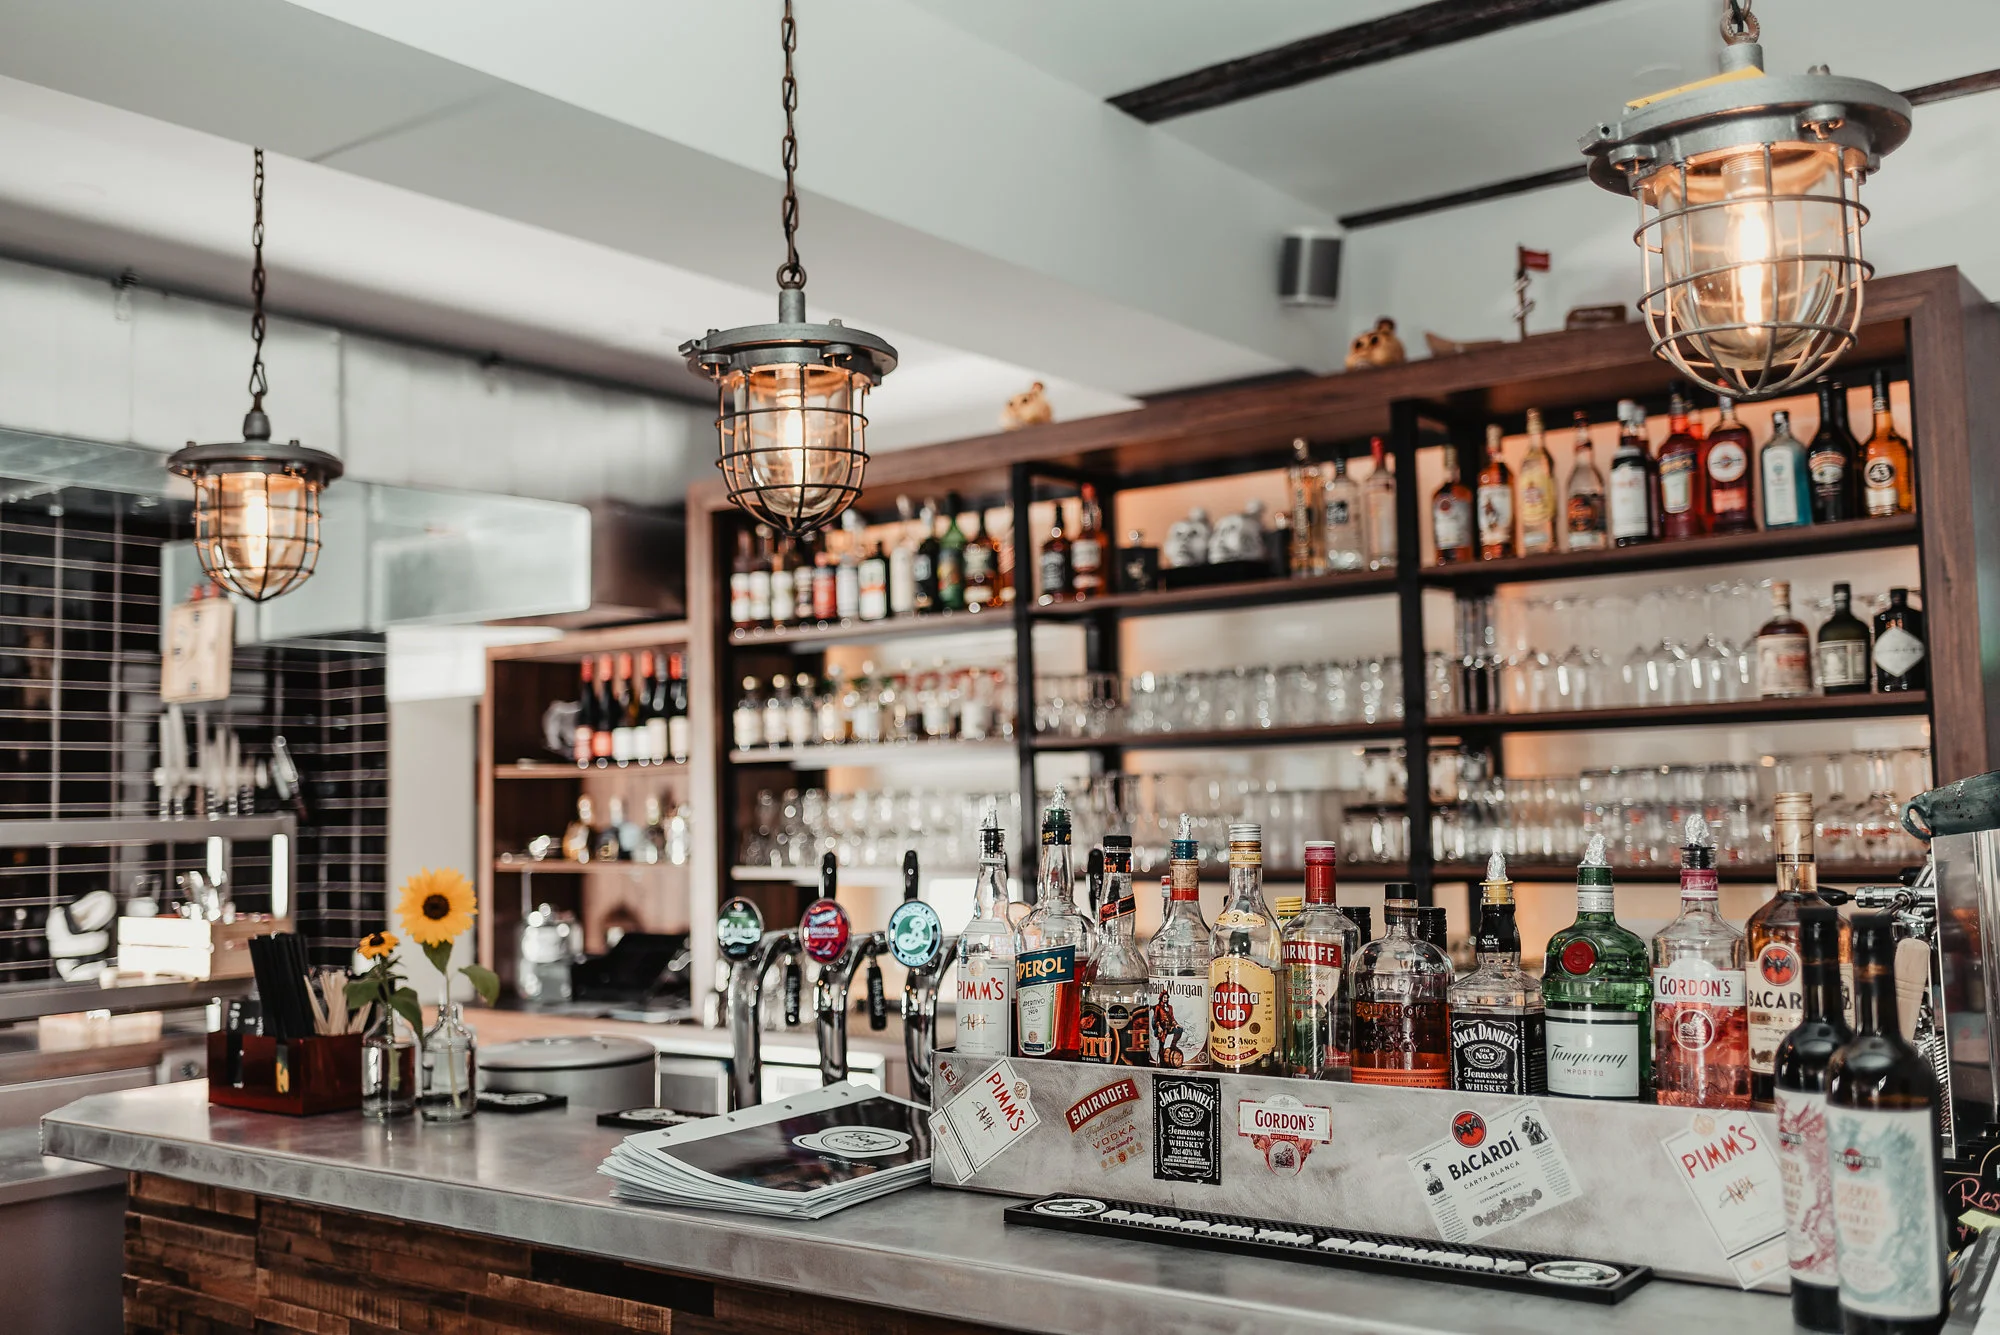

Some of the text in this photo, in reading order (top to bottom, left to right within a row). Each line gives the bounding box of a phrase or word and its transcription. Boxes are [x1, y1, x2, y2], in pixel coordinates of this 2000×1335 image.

[958, 977, 1004, 1001] PIMM'S
[1149, 980, 1203, 998] tain Morgan
[1210, 987, 1260, 1005] Havana
[1660, 975, 1731, 997] GORDON'S
[1749, 990, 1803, 1010] BACAR
[1214, 1005, 1246, 1022] Club
[1227, 1035, 1236, 1049] 3
[1452, 1023, 1521, 1050] JACK DANIEL'S
[1551, 1044, 1628, 1069] Tanqueray
[1463, 1067, 1508, 1080] Tennessee
[1563, 1068, 1604, 1077] IMPORTED
[1159, 1084, 1215, 1111] JACK DANIEL'S
[1464, 1082, 1508, 1093] WHISKEY
[985, 1071, 1025, 1132] PIMM'S
[1071, 1083, 1129, 1125] SMIRNOFF
[1177, 1111, 1194, 1119] No.7
[1255, 1109, 1315, 1131] GORDON'S
[1092, 1125, 1136, 1149] VODKA
[1167, 1124, 1205, 1137] Tennessee
[1168, 1139, 1205, 1149] WHISKEY
[1681, 1124, 1757, 1179] PIMM'S
[1447, 1130, 1520, 1181] BACARDÍ
[1463, 1160, 1521, 1190] CARTA BLANCA
